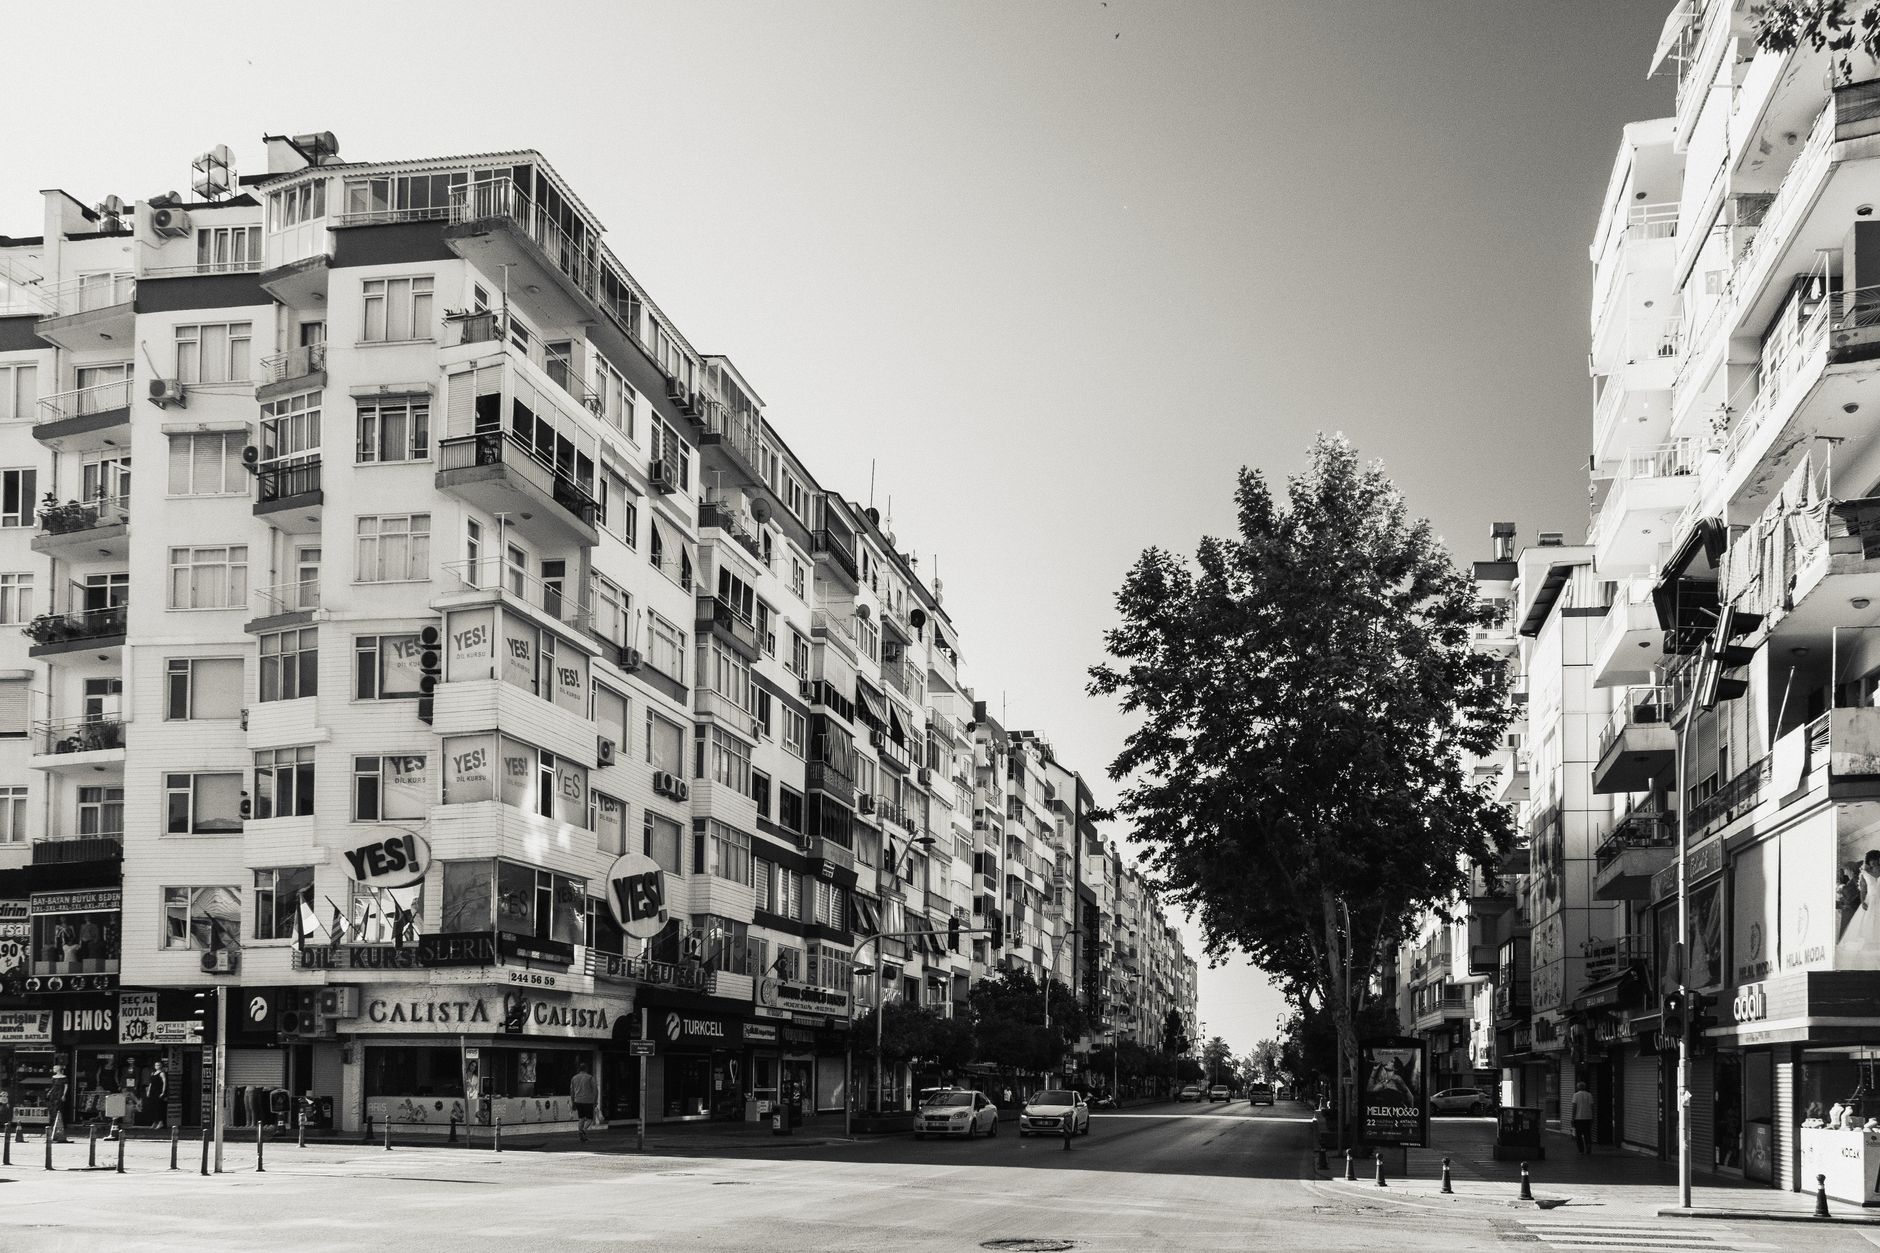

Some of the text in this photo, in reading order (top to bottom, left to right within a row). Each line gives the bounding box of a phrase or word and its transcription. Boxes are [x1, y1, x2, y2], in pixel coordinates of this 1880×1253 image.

[453, 625, 487, 651] YES!
[506, 637, 530, 661] YES!
[557, 667, 581, 688] YES!
[453, 748, 487, 774] YES!
[504, 757, 529, 777] YES!
[556, 767, 582, 799] YES
[344, 834, 420, 881] YES!
[613, 869, 670, 924] YES!
[1804, 945, 1826, 965] MODA
[511, 972, 555, 986] 244 56 59
[121, 995, 156, 1007] SEÇ AL
[369, 999, 490, 1023] CALISTA
[63, 1009, 112, 1031] DEMOS
[122, 1007, 155, 1018] KOTLAR
[534, 1002, 609, 1030] CALISTA
[129, 1021, 143, 1037] 60
[683, 1018, 725, 1037] TURKCELL
[1366, 1105, 1392, 1118] MELEK
[1366, 1118, 1377, 1127] 22
